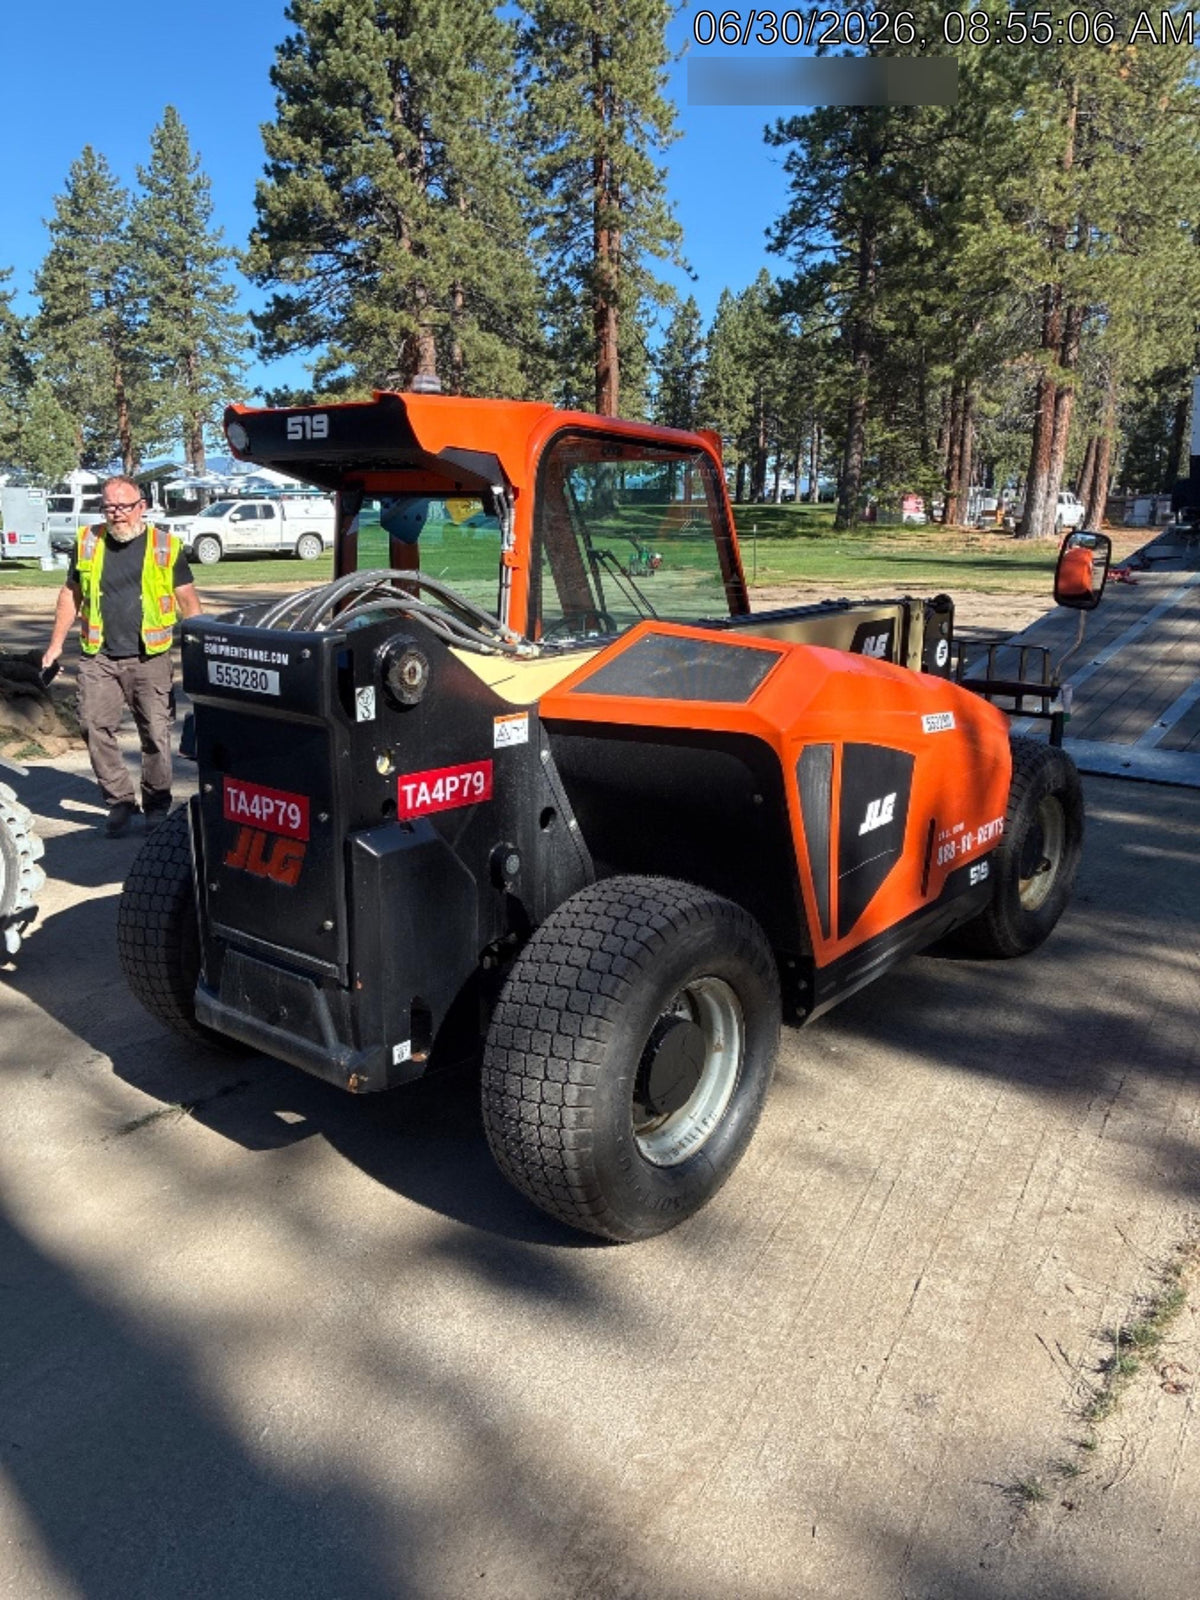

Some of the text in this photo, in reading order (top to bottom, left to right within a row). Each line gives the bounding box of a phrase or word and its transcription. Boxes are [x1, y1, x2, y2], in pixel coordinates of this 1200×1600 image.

[287, 413, 329, 440] 519
[215, 664, 269, 690] 553280
[226, 787, 302, 830] TA4P79
[399, 769, 485, 810] TA4P79
[858, 792, 897, 837] JLG
[224, 826, 307, 887] JLG
